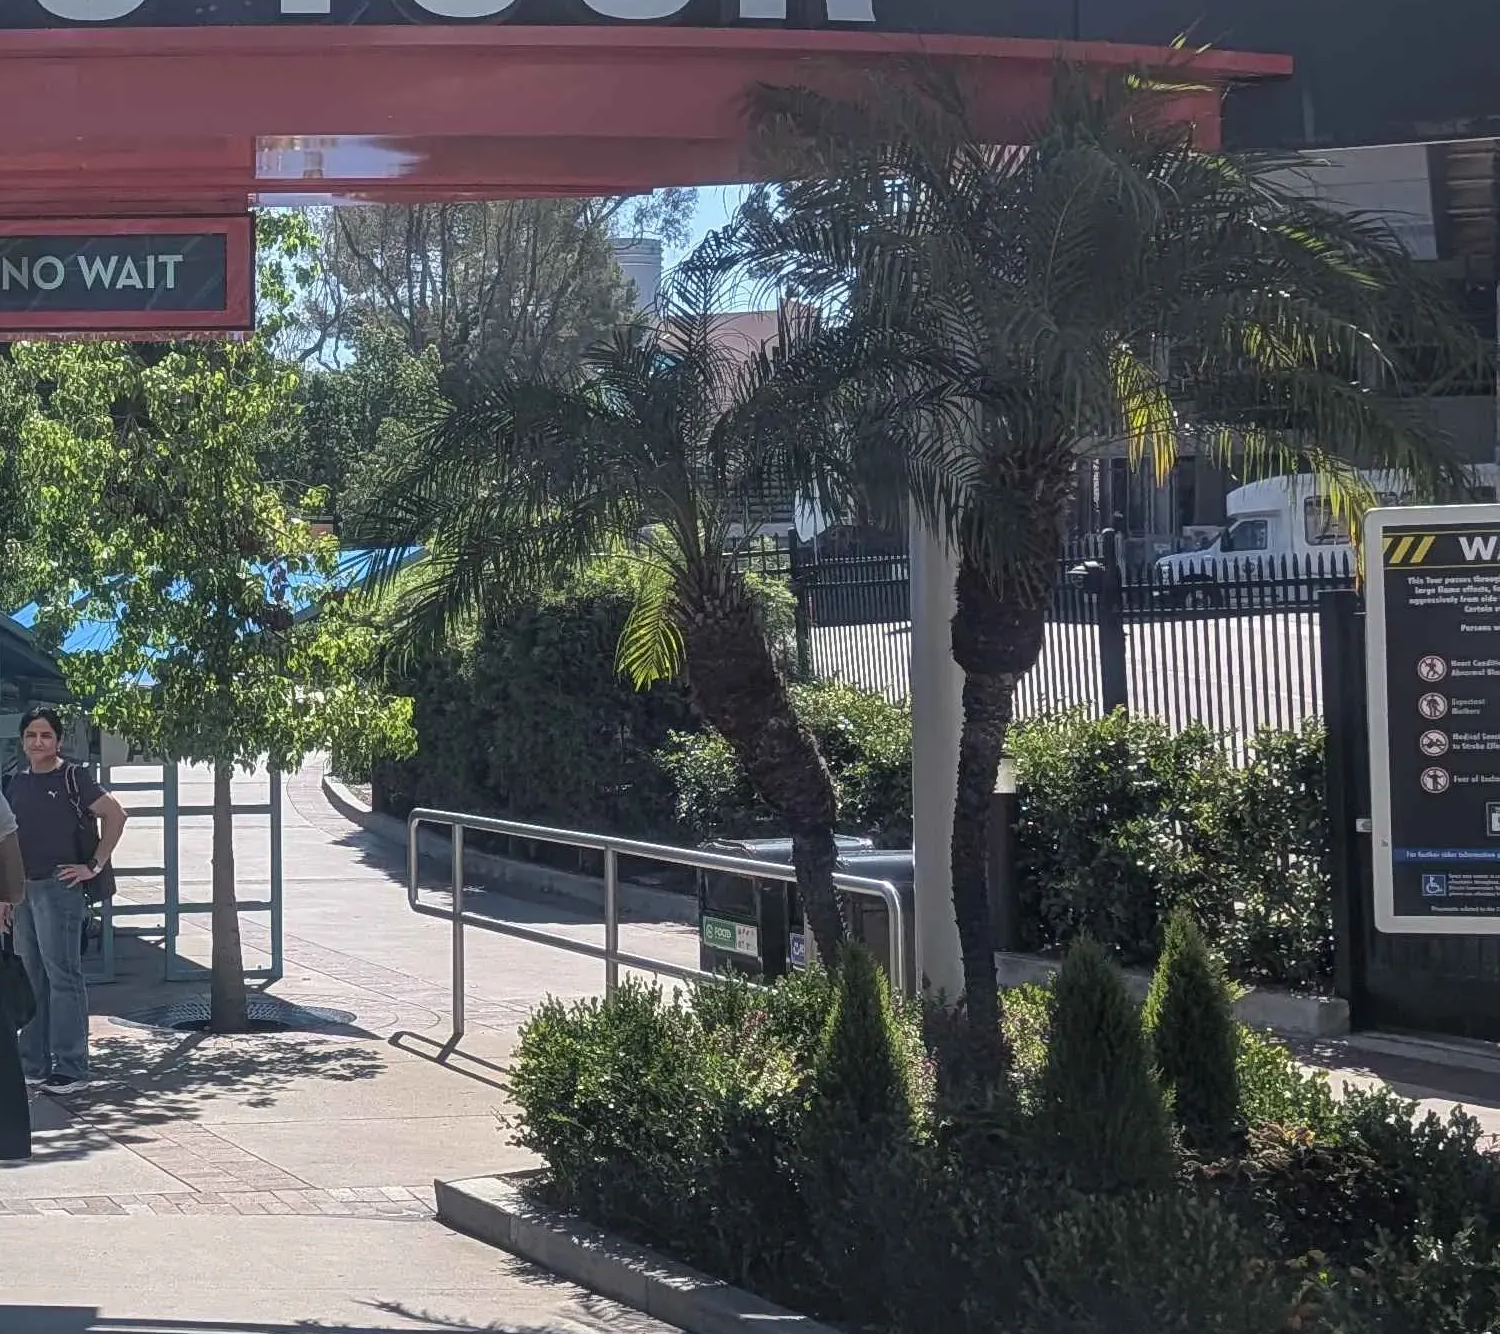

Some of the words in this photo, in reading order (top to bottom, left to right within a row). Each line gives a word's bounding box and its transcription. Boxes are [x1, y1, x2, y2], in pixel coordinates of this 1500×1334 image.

[1, 255, 66, 291] NO
[76, 254, 184, 291] WAIT
[1473, 574, 1500, 586] throug
